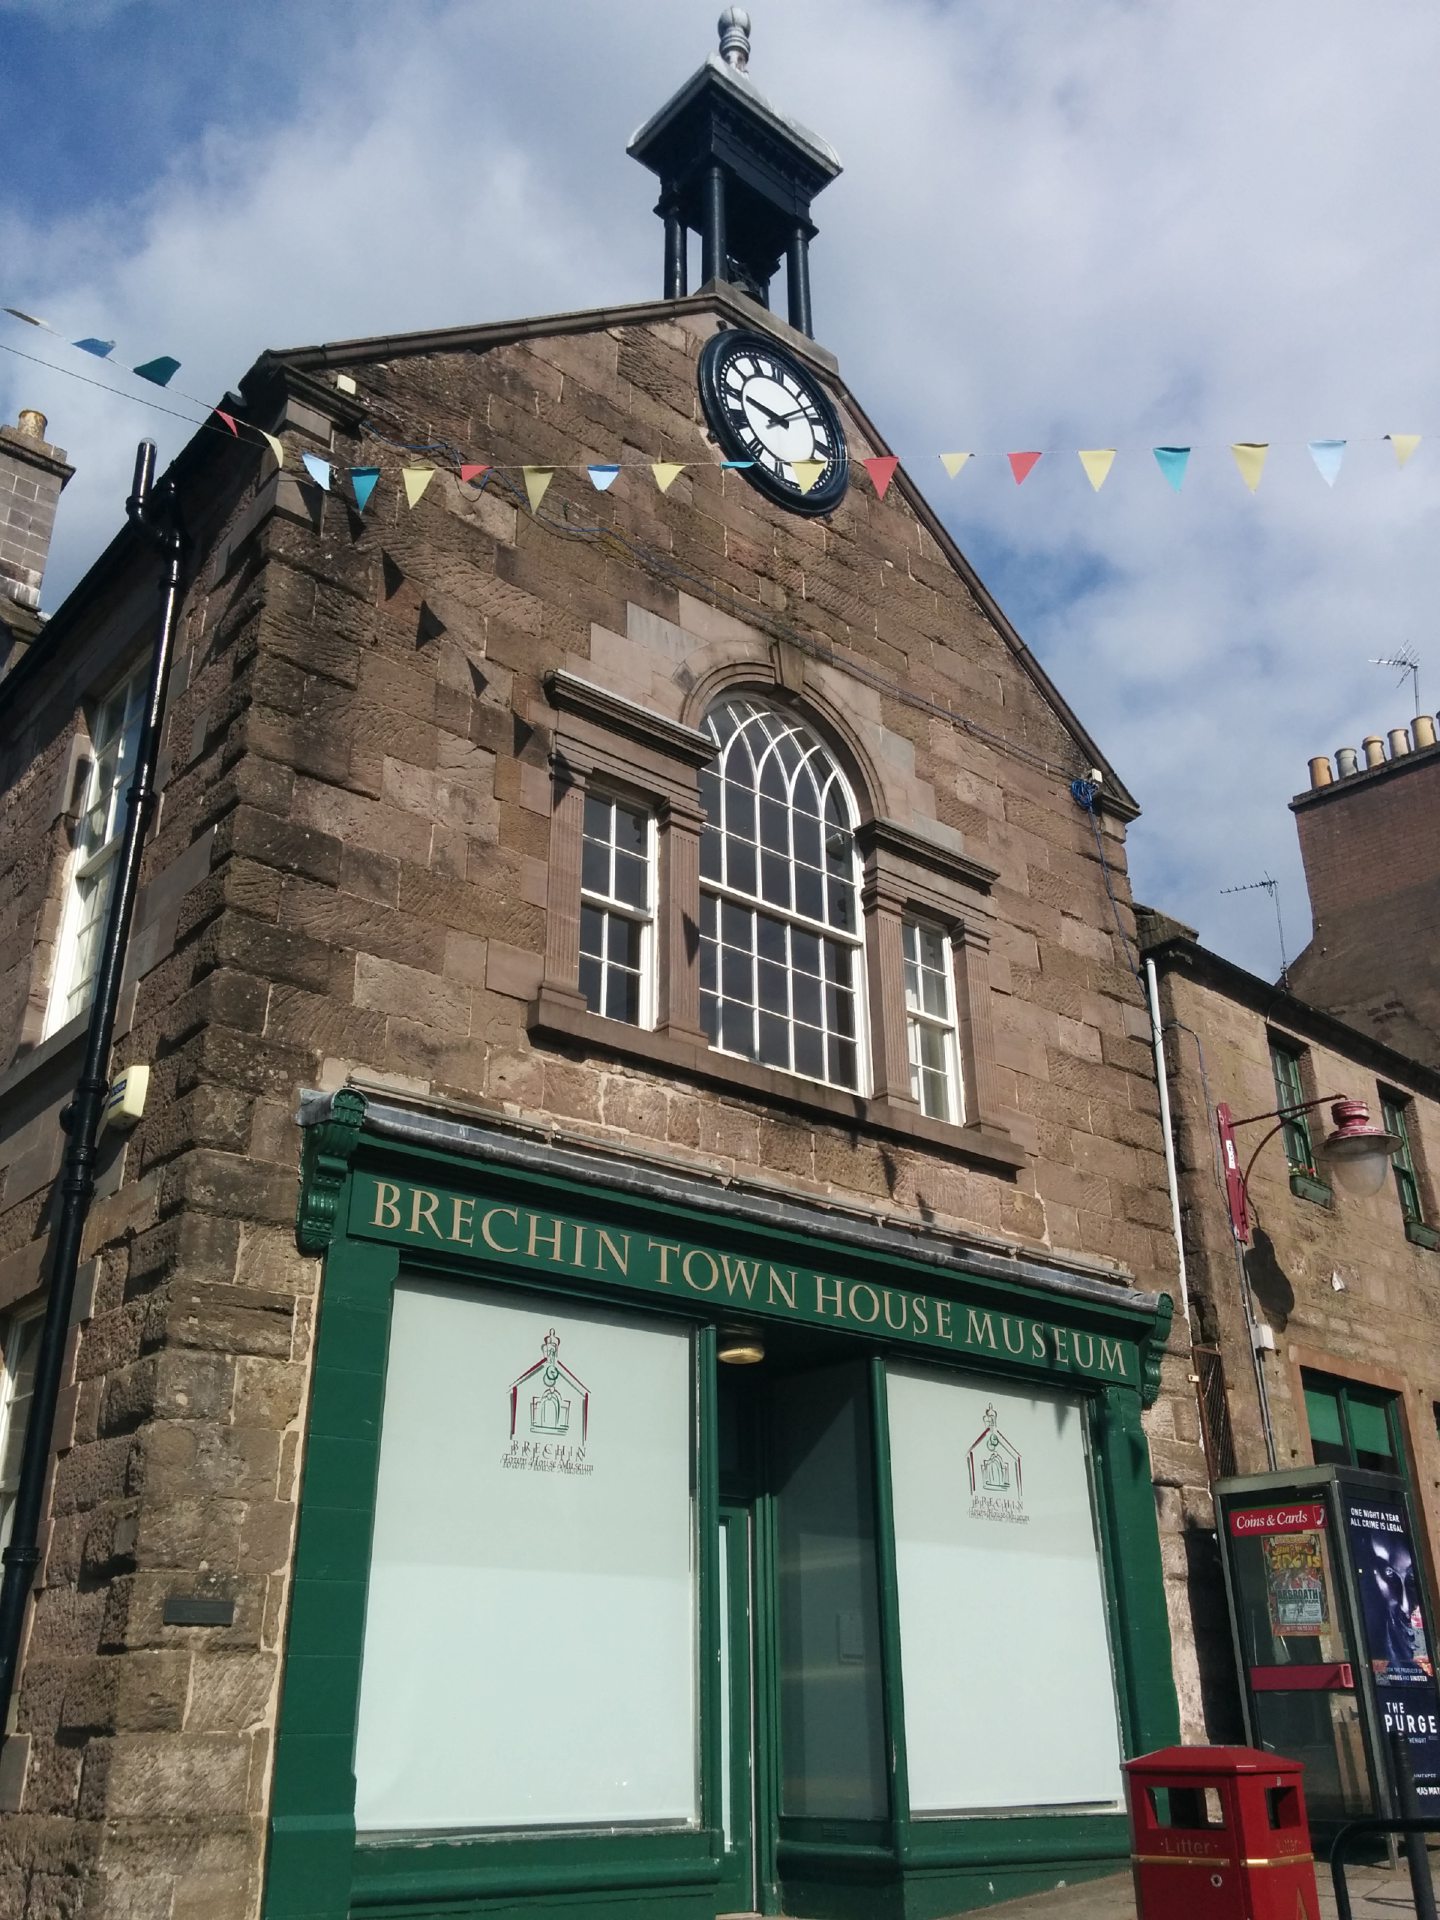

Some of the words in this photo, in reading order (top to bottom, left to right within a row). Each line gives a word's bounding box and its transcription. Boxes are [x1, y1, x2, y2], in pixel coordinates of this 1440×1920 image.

[368, 1180, 631, 1277] BRECHIN
[647, 1237, 799, 1310] TOWN
[812, 1275, 953, 1340] HOUSE
[965, 1308, 1128, 1376] MUSEUM
[511, 1440, 586, 1460] BRECHIN
[1236, 1515, 1265, 1529] Coins
[1266, 1514, 1275, 1526] &
[1277, 1510, 1308, 1525] Cards
[1351, 1507, 1362, 1517] ONE
[1363, 1509, 1379, 1519] NIGHT
[1385, 1513, 1400, 1522] YEAR
[1351, 1518, 1361, 1527] ALL
[1362, 1520, 1379, 1530] CRIME
[1380, 1522, 1386, 1530] IS
[1387, 1523, 1404, 1533] LEGAL
[1386, 1701, 1405, 1714] THE
[1384, 1714, 1438, 1734] PURGE
[1165, 1837, 1210, 1854] Litter
